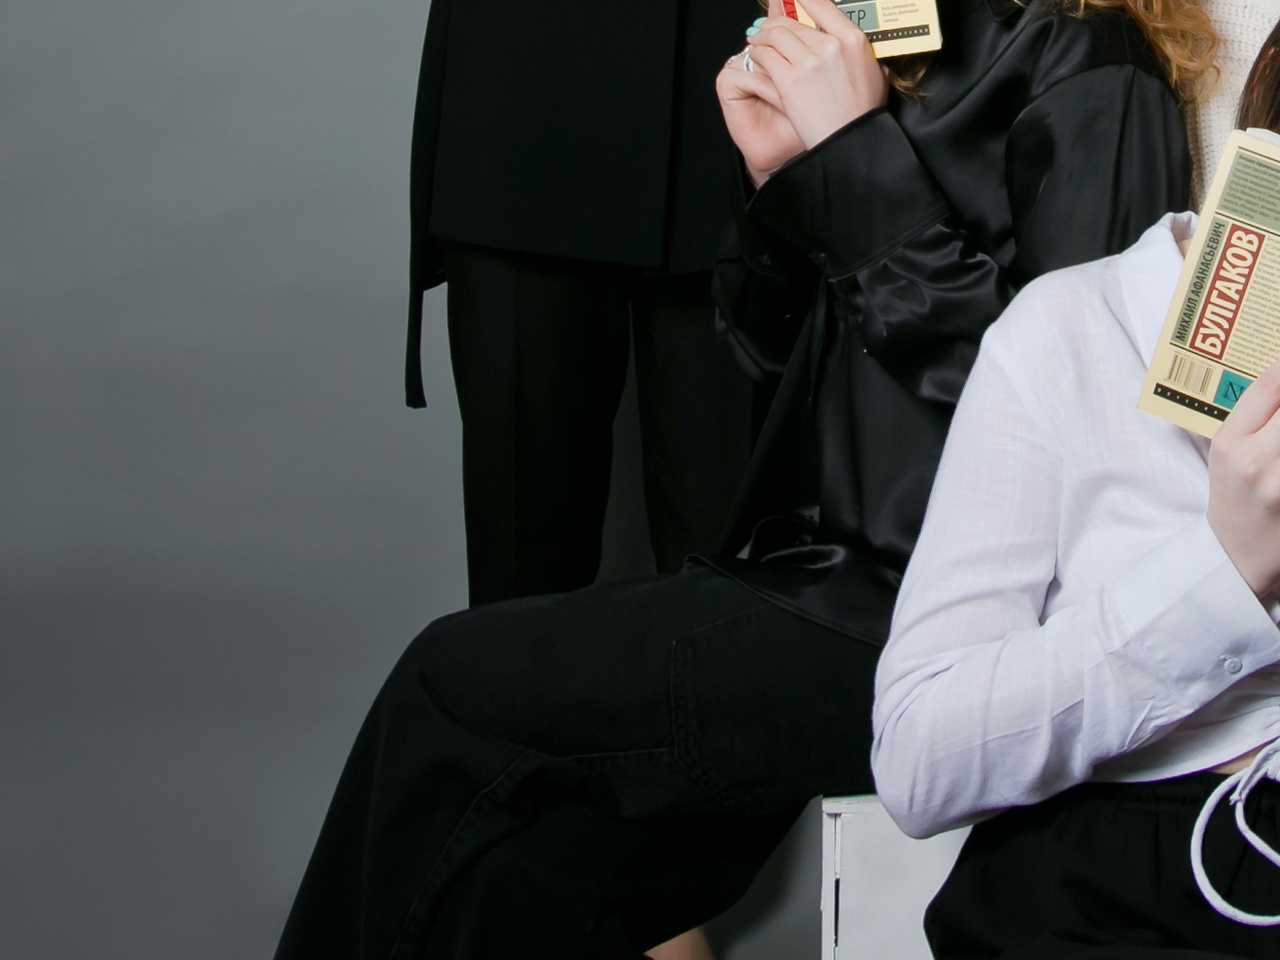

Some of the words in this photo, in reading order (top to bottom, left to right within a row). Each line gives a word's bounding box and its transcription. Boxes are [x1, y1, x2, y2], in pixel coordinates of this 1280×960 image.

[1175, 293, 1200, 342] МИХАИЛ
[1191, 221, 1226, 297] АФАНАСЬЕВИЧ
[1194, 229, 1260, 356] БУЛГАКОВ
